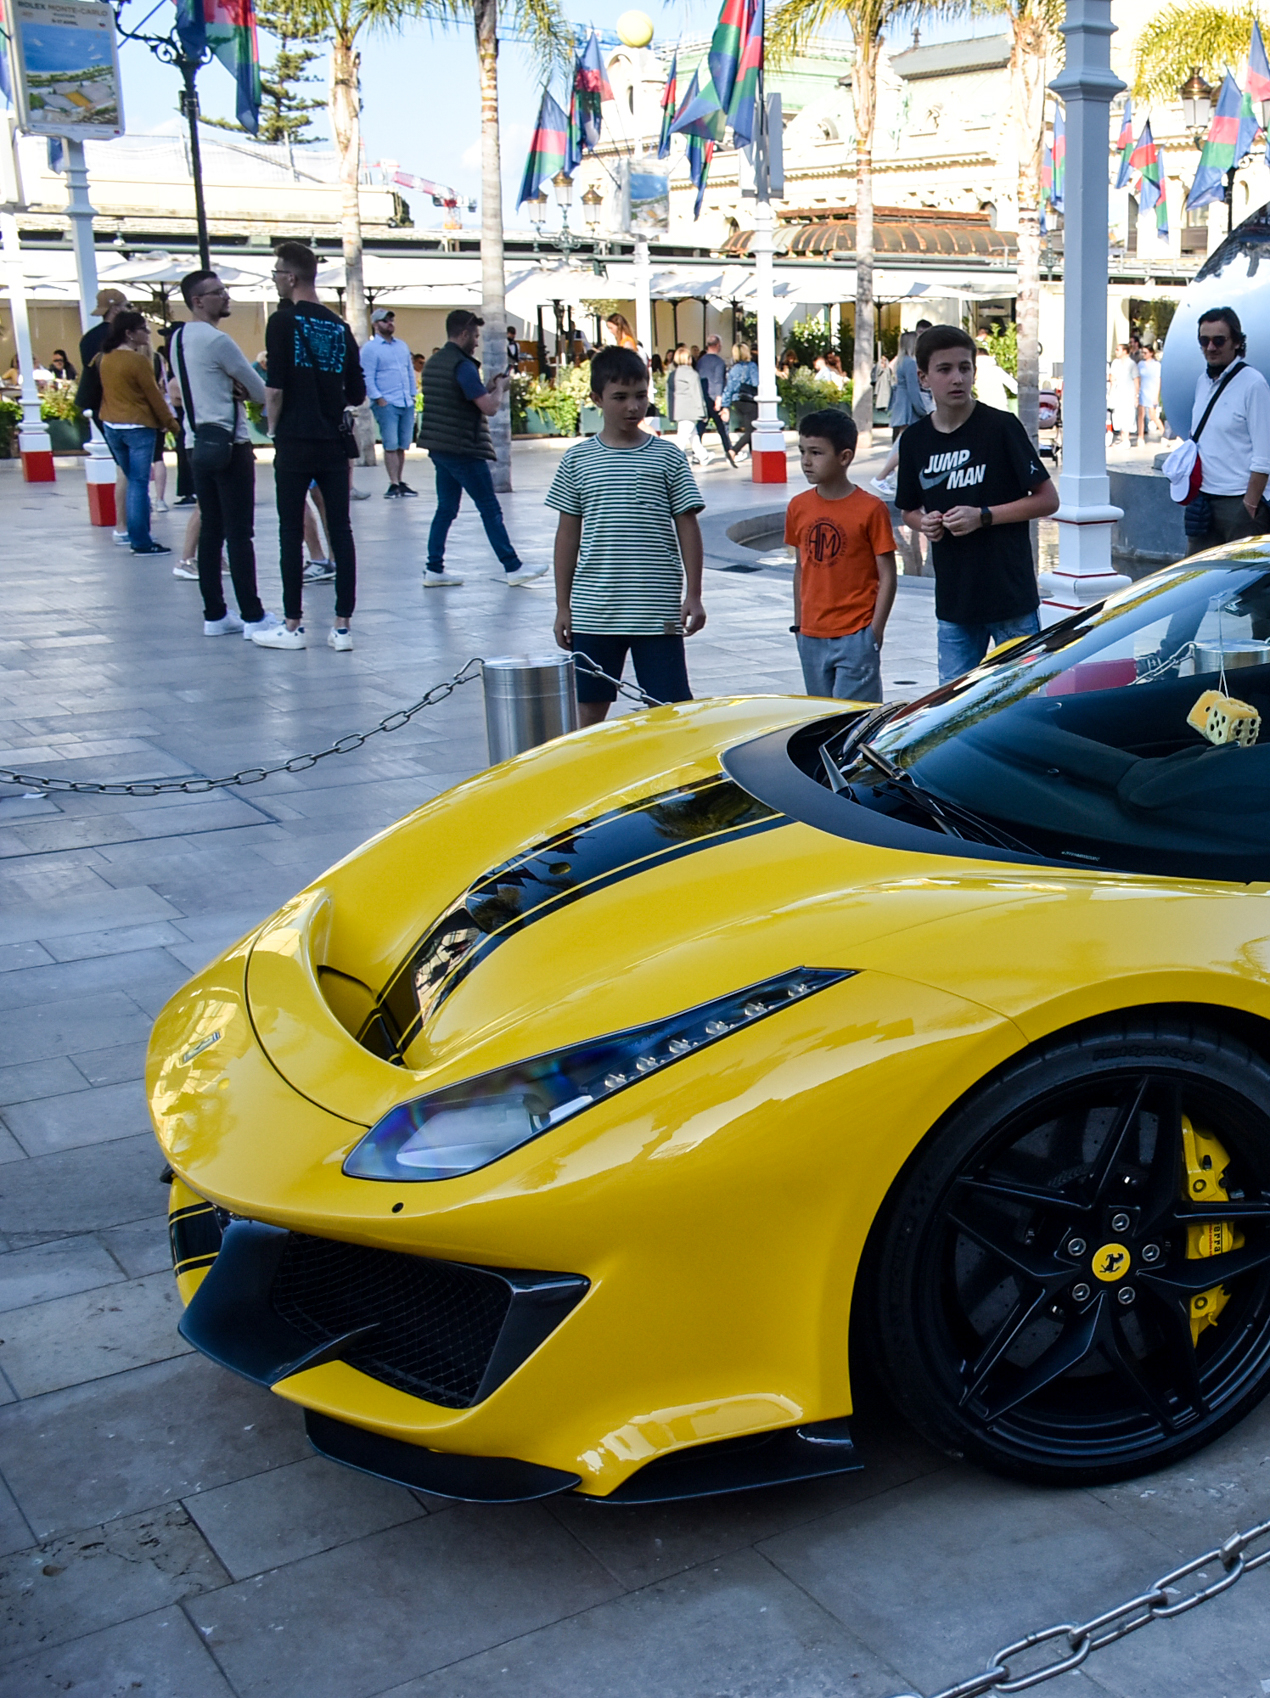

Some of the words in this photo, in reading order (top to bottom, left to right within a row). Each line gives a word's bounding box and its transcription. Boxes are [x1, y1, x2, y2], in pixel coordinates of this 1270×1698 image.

[18, 1, 46, 10] ROLEX
[47, 4, 108, 17] MONTE-CARLO
[924, 449, 971, 474] JUMP
[946, 464, 986, 490] MAN
[1128, 1045, 1168, 1057] Sport
[1169, 1048, 1192, 1061] Cup
